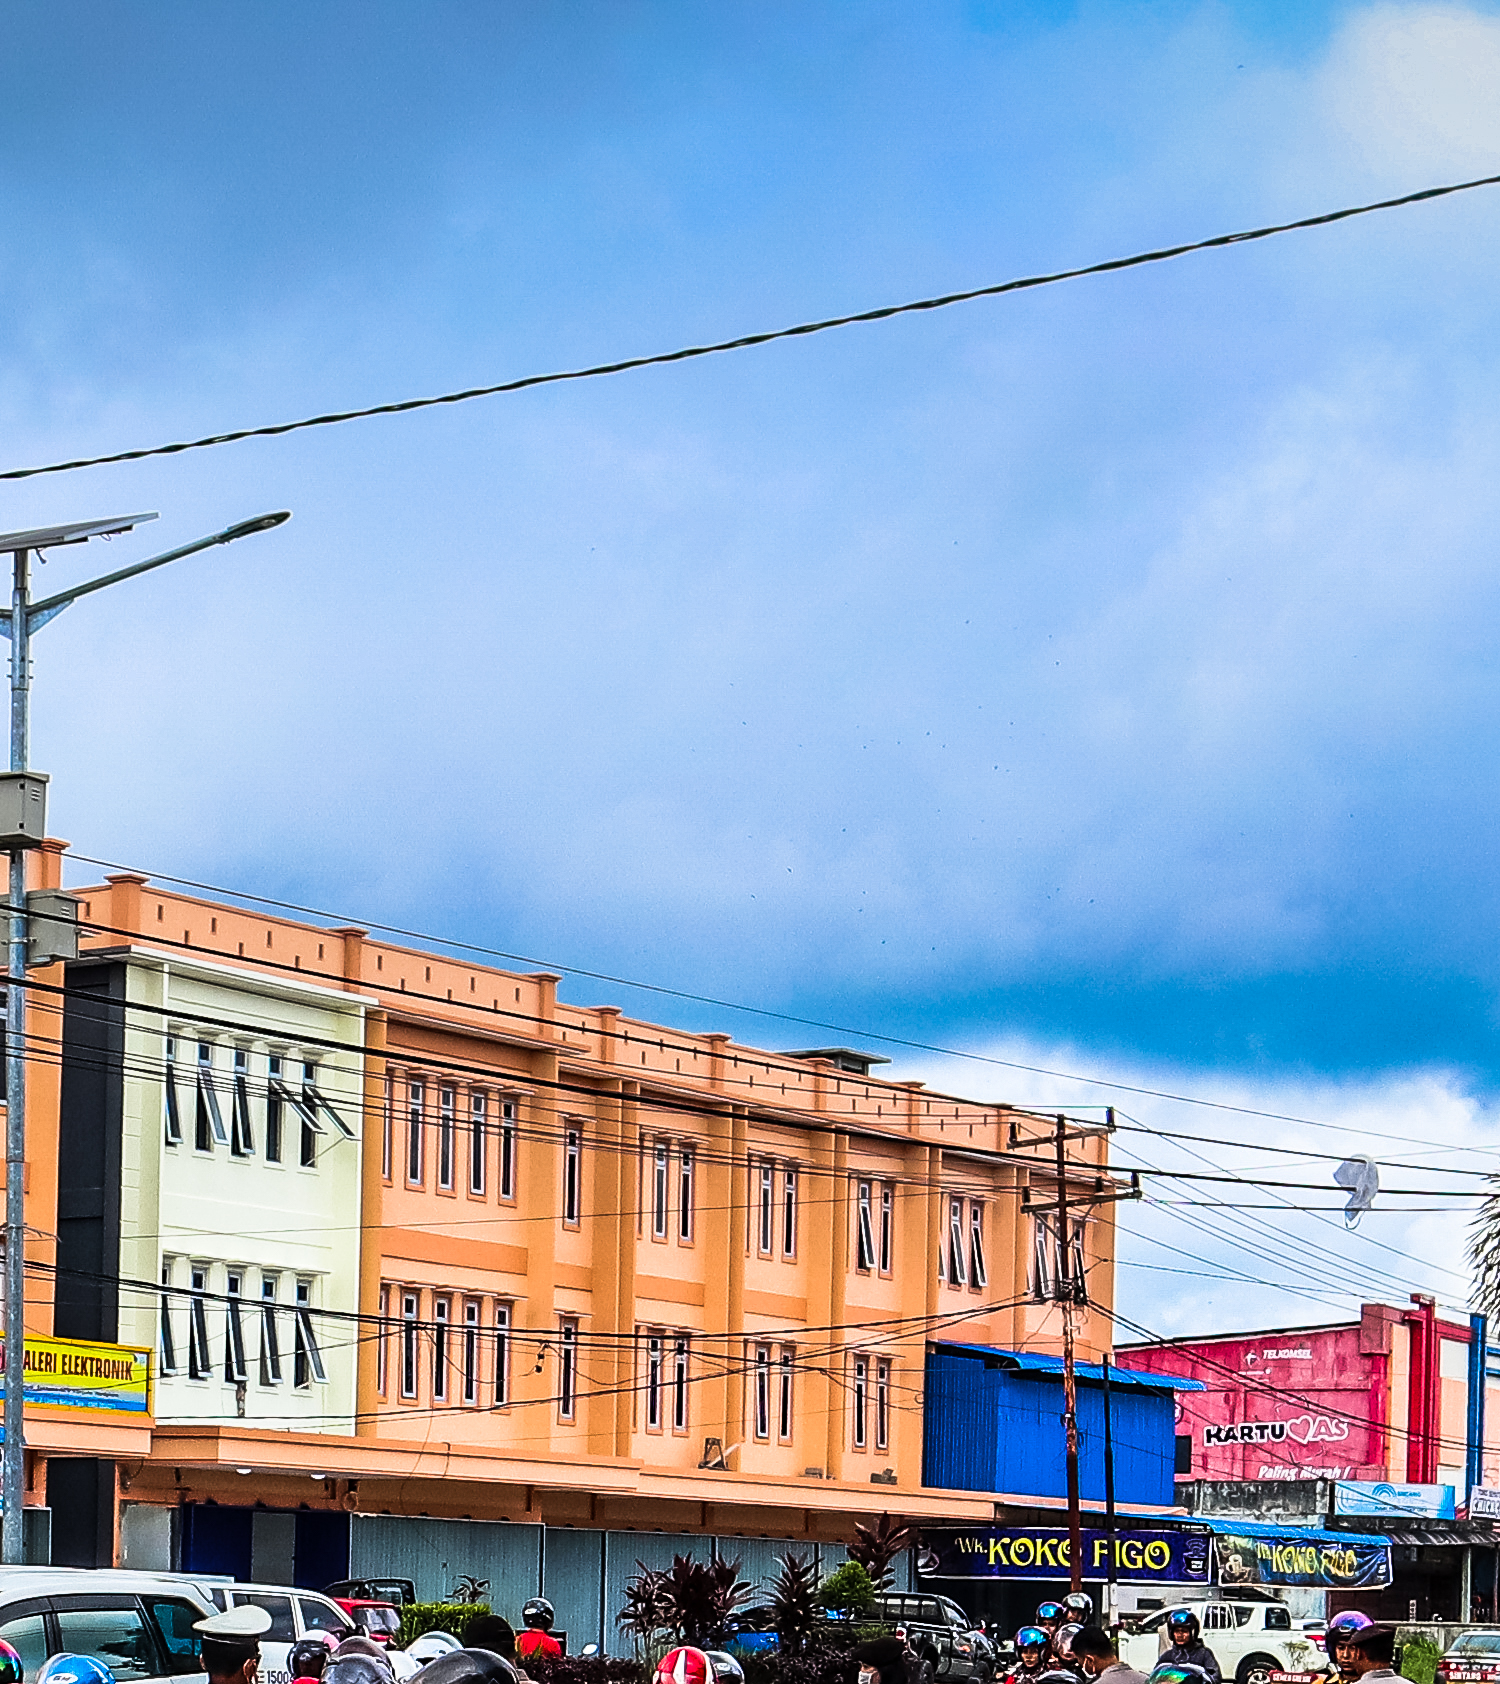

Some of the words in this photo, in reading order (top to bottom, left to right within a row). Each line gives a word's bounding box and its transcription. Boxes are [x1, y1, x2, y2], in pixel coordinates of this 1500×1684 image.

[23, 1350, 58, 1374] ALERI
[62, 1354, 133, 1381] ELEKTRONIK
[1263, 1349, 1313, 1359] TELKOMSEL
[1204, 1422, 1287, 1446] KARTU
[1310, 1416, 1349, 1441] AS
[1258, 1465, 1298, 1481] Paling
